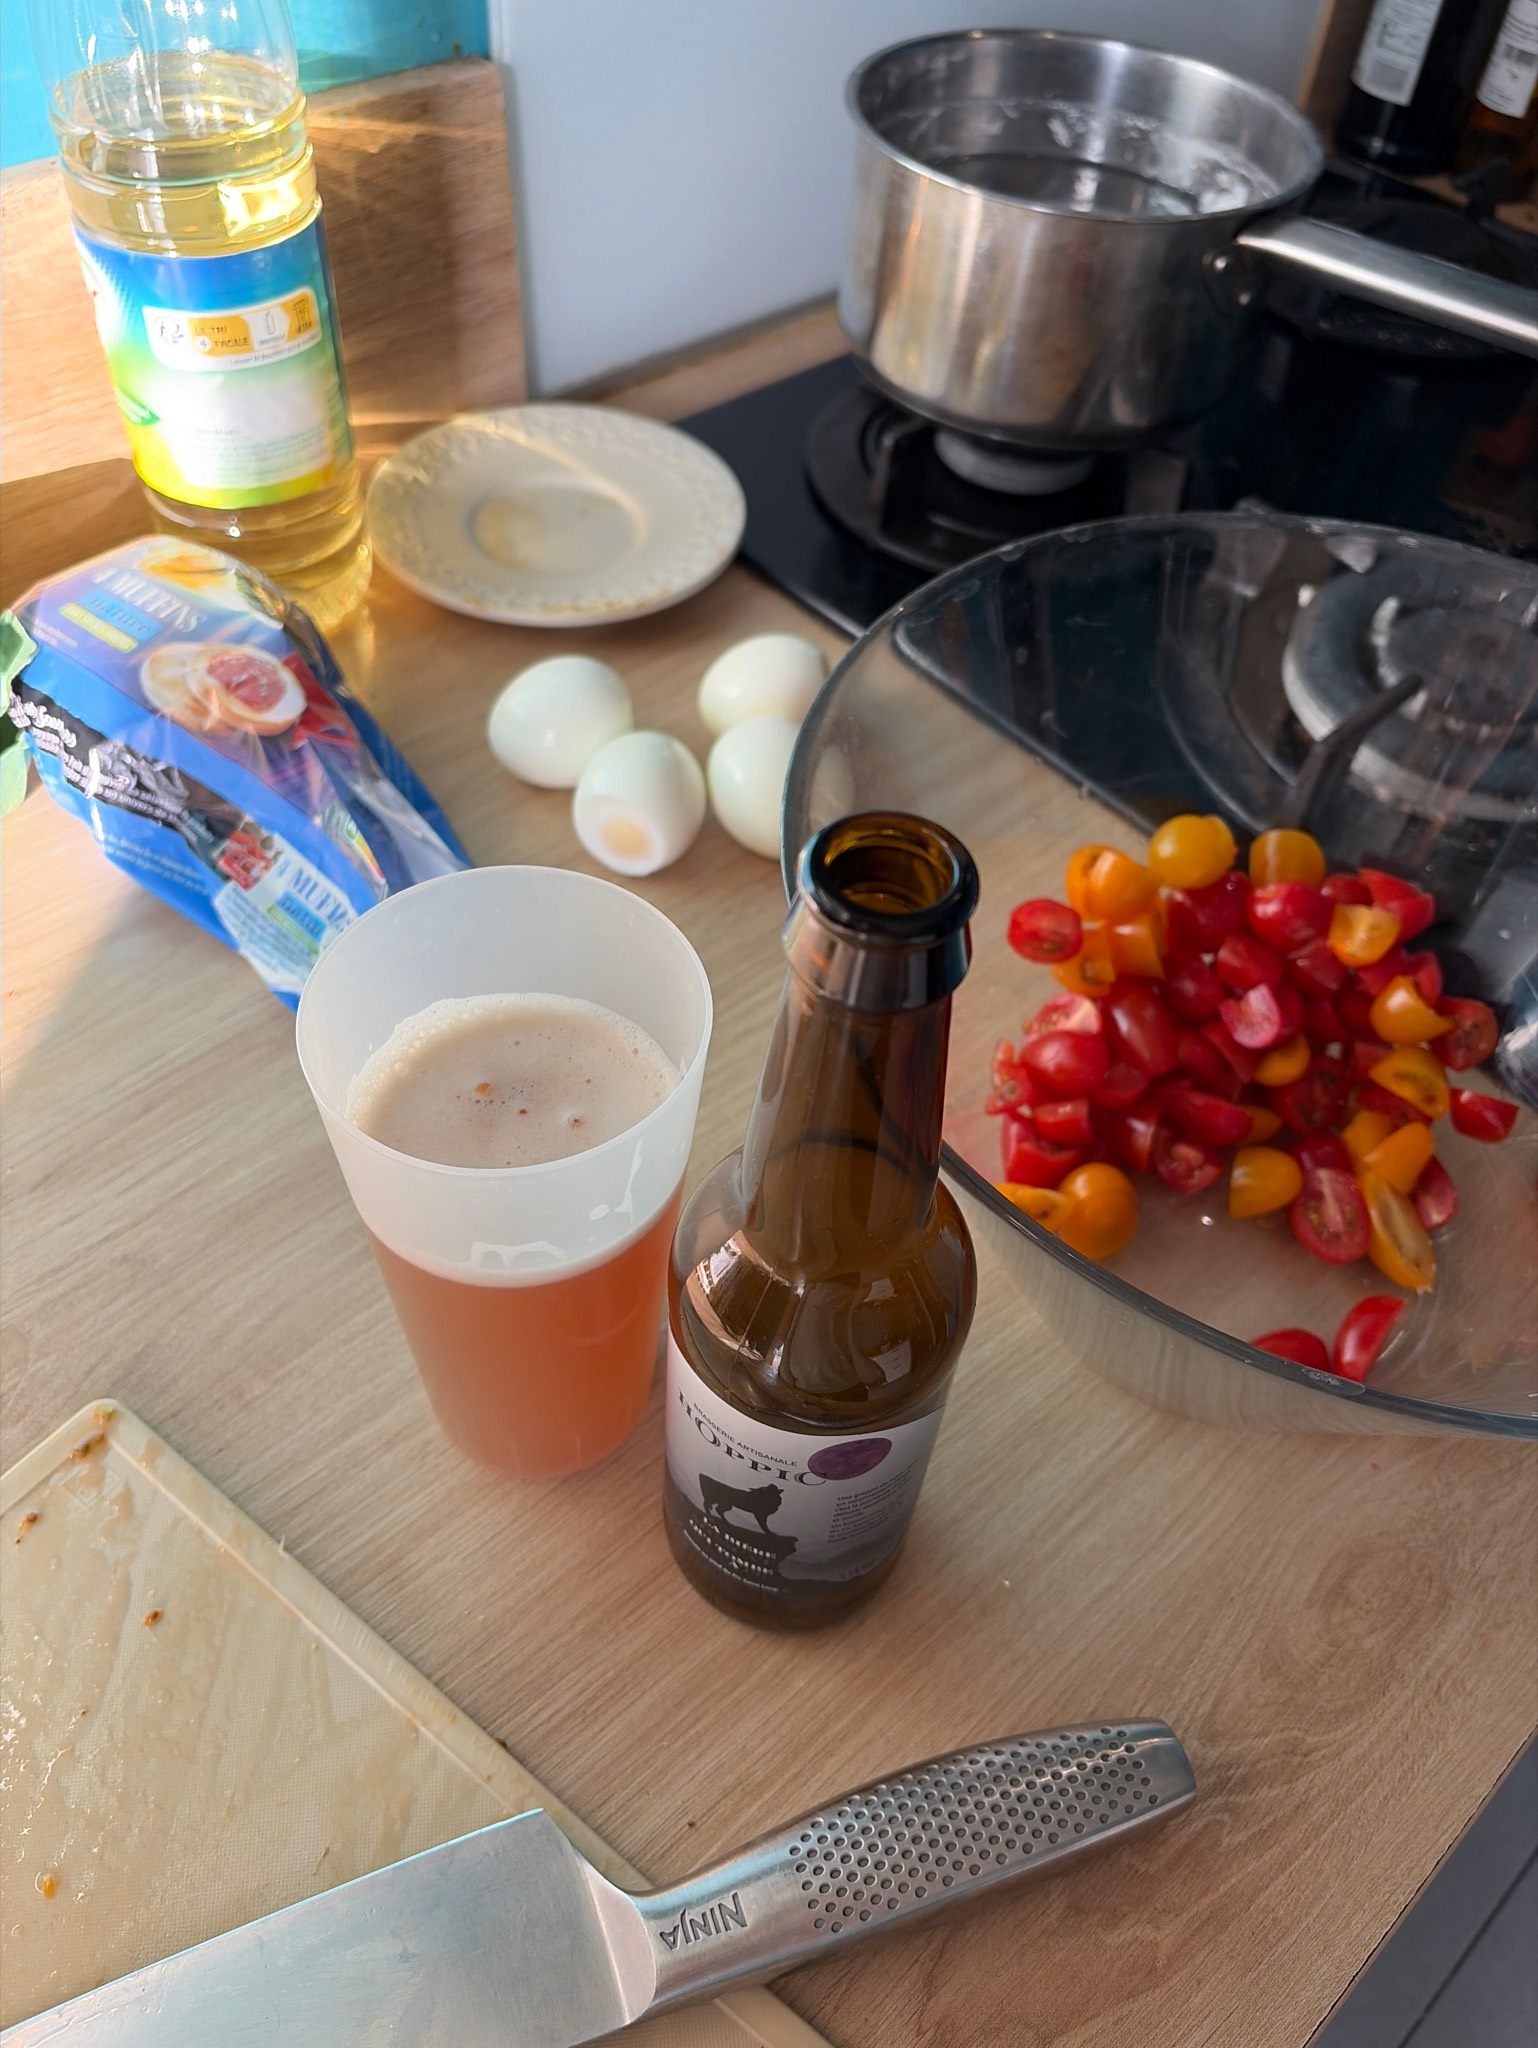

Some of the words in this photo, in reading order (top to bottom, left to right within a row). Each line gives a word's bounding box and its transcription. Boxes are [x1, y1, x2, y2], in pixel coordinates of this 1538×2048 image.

[89, 597, 150, 634] nature
[104, 570, 207, 633] MUFFINS
[693, 1402, 736, 1443] BRASSERIE
[737, 1441, 799, 1468] ARTISANALE
[703, 1516, 721, 1534] LA
[659, 1891, 749, 1951] NINJA
